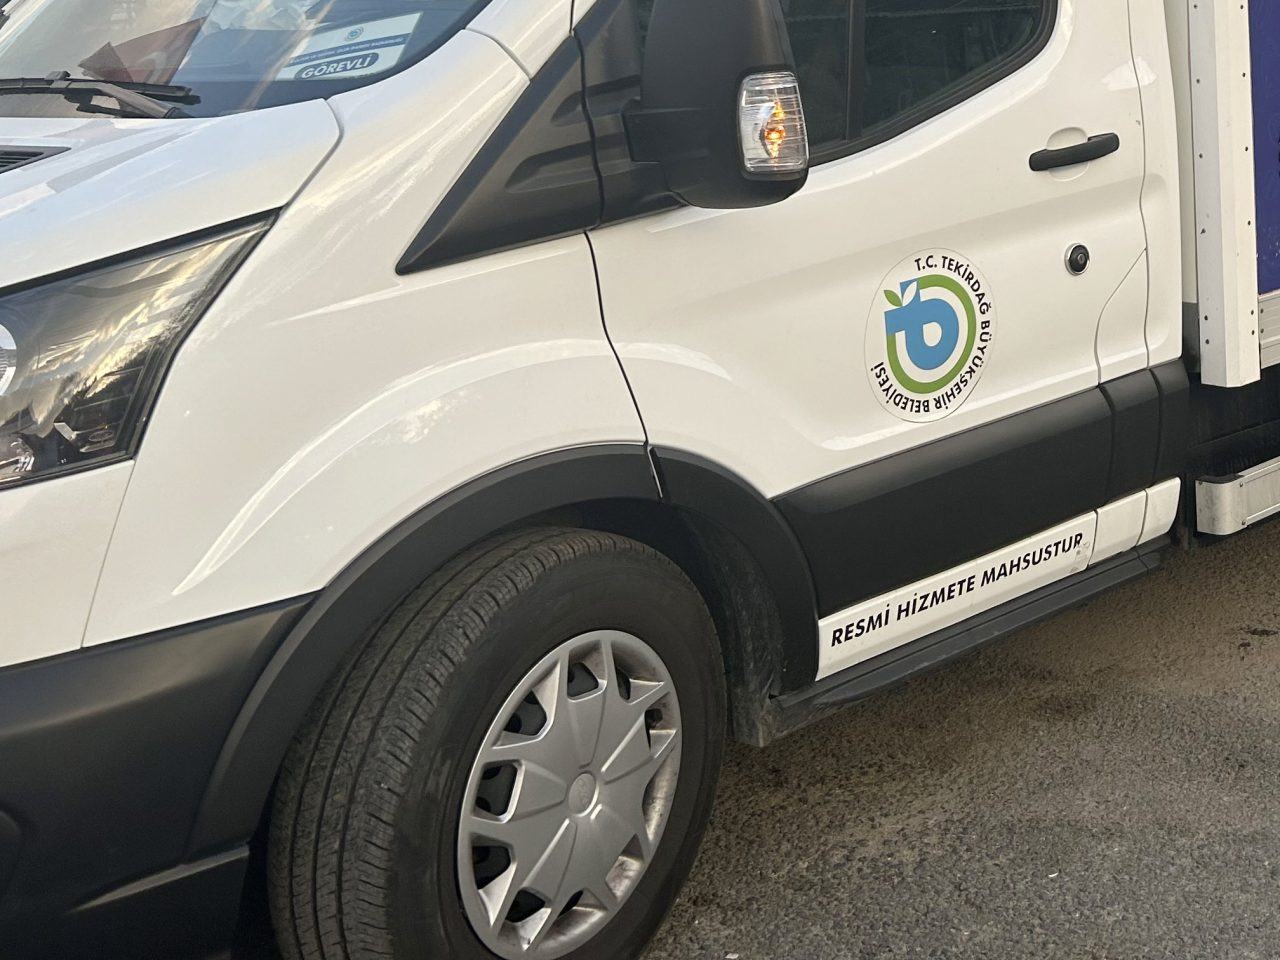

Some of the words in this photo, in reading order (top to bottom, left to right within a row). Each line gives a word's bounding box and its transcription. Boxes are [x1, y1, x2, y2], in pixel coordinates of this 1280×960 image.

[301, 52, 372, 80] GÖREVLİ
[914, 254, 938, 272] T.C.
[941, 255, 992, 315] TEKİRDAĞ
[870, 361, 930, 414] BELEDİYESİ
[934, 320, 992, 410] BÜYÜKŞEHİR
[831, 602, 891, 648] RESMİ
[896, 574, 976, 622] HİZMETE
[980, 532, 1084, 588] MAHSUSTUR
